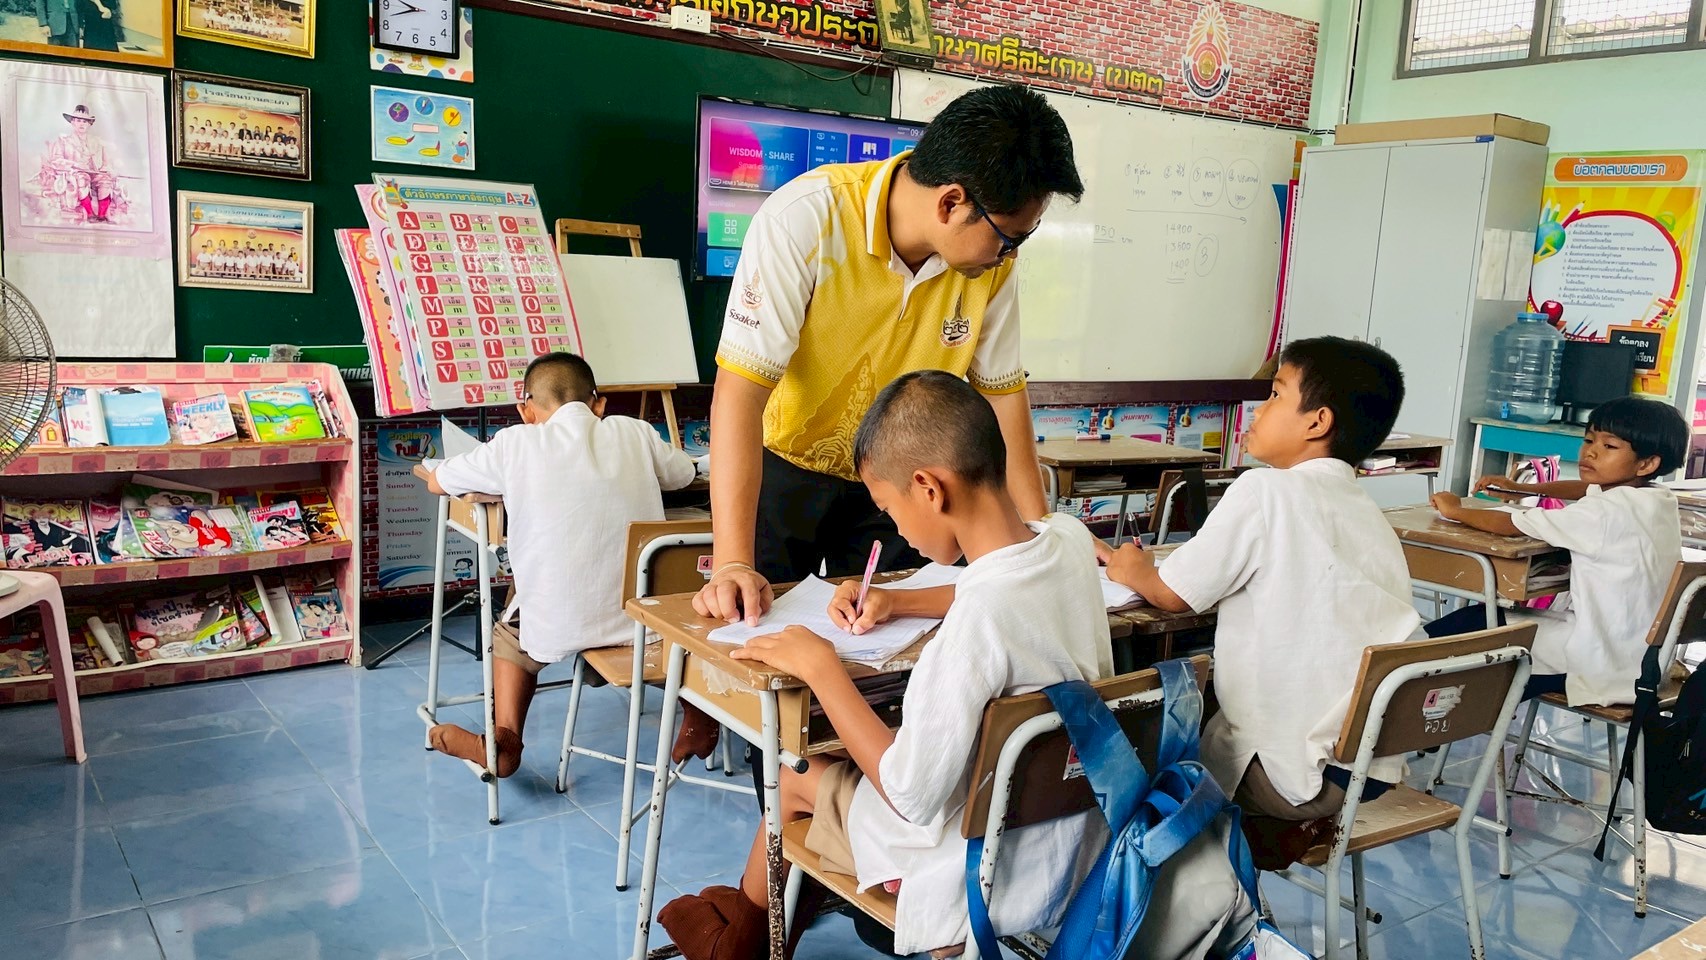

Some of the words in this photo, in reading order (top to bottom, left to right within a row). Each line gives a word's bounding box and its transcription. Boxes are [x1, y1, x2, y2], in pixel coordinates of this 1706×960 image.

[382, 0, 390, 10] 9
[440, 10, 448, 20] 3
[382, 20, 390, 30] 8
[395, 31, 402, 41] 7
[412, 33, 419, 44] 6
[440, 28, 447, 38] 4
[429, 36, 436, 47] 5
[729, 146, 763, 159] WISDOM
[768, 151, 795, 162] SHARE
[1574, 158, 1666, 176] ข้อตกลงของเรา
[404, 187, 502, 205] ตัวอักษรภาษาอังกฤษ
[402, 213, 417, 228] A
[451, 215, 467, 230] B
[503, 217, 516, 232] C
[405, 234, 422, 250] D
[459, 235, 475, 251] E
[413, 255, 429, 270] G
[420, 277, 430, 294] J
[470, 278, 489, 293] K
[423, 297, 442, 314] M
[474, 297, 491, 313] N
[525, 296, 539, 312] O
[529, 317, 544, 332] R
[729, 308, 760, 329] Sisaket
[429, 320, 443, 335] P
[481, 318, 497, 336] Q
[434, 342, 447, 358] S
[485, 340, 499, 356] T
[534, 339, 547, 354] U
[438, 364, 453, 381] V
[490, 361, 507, 377] W
[465, 386, 481, 403] Y
[182, 400, 226, 415] WEEKLY
[386, 517, 432, 525] Wednesday
[386, 553, 422, 561] Saturday
[702, 558, 709, 568] 4
[1428, 693, 1436, 705] 4
